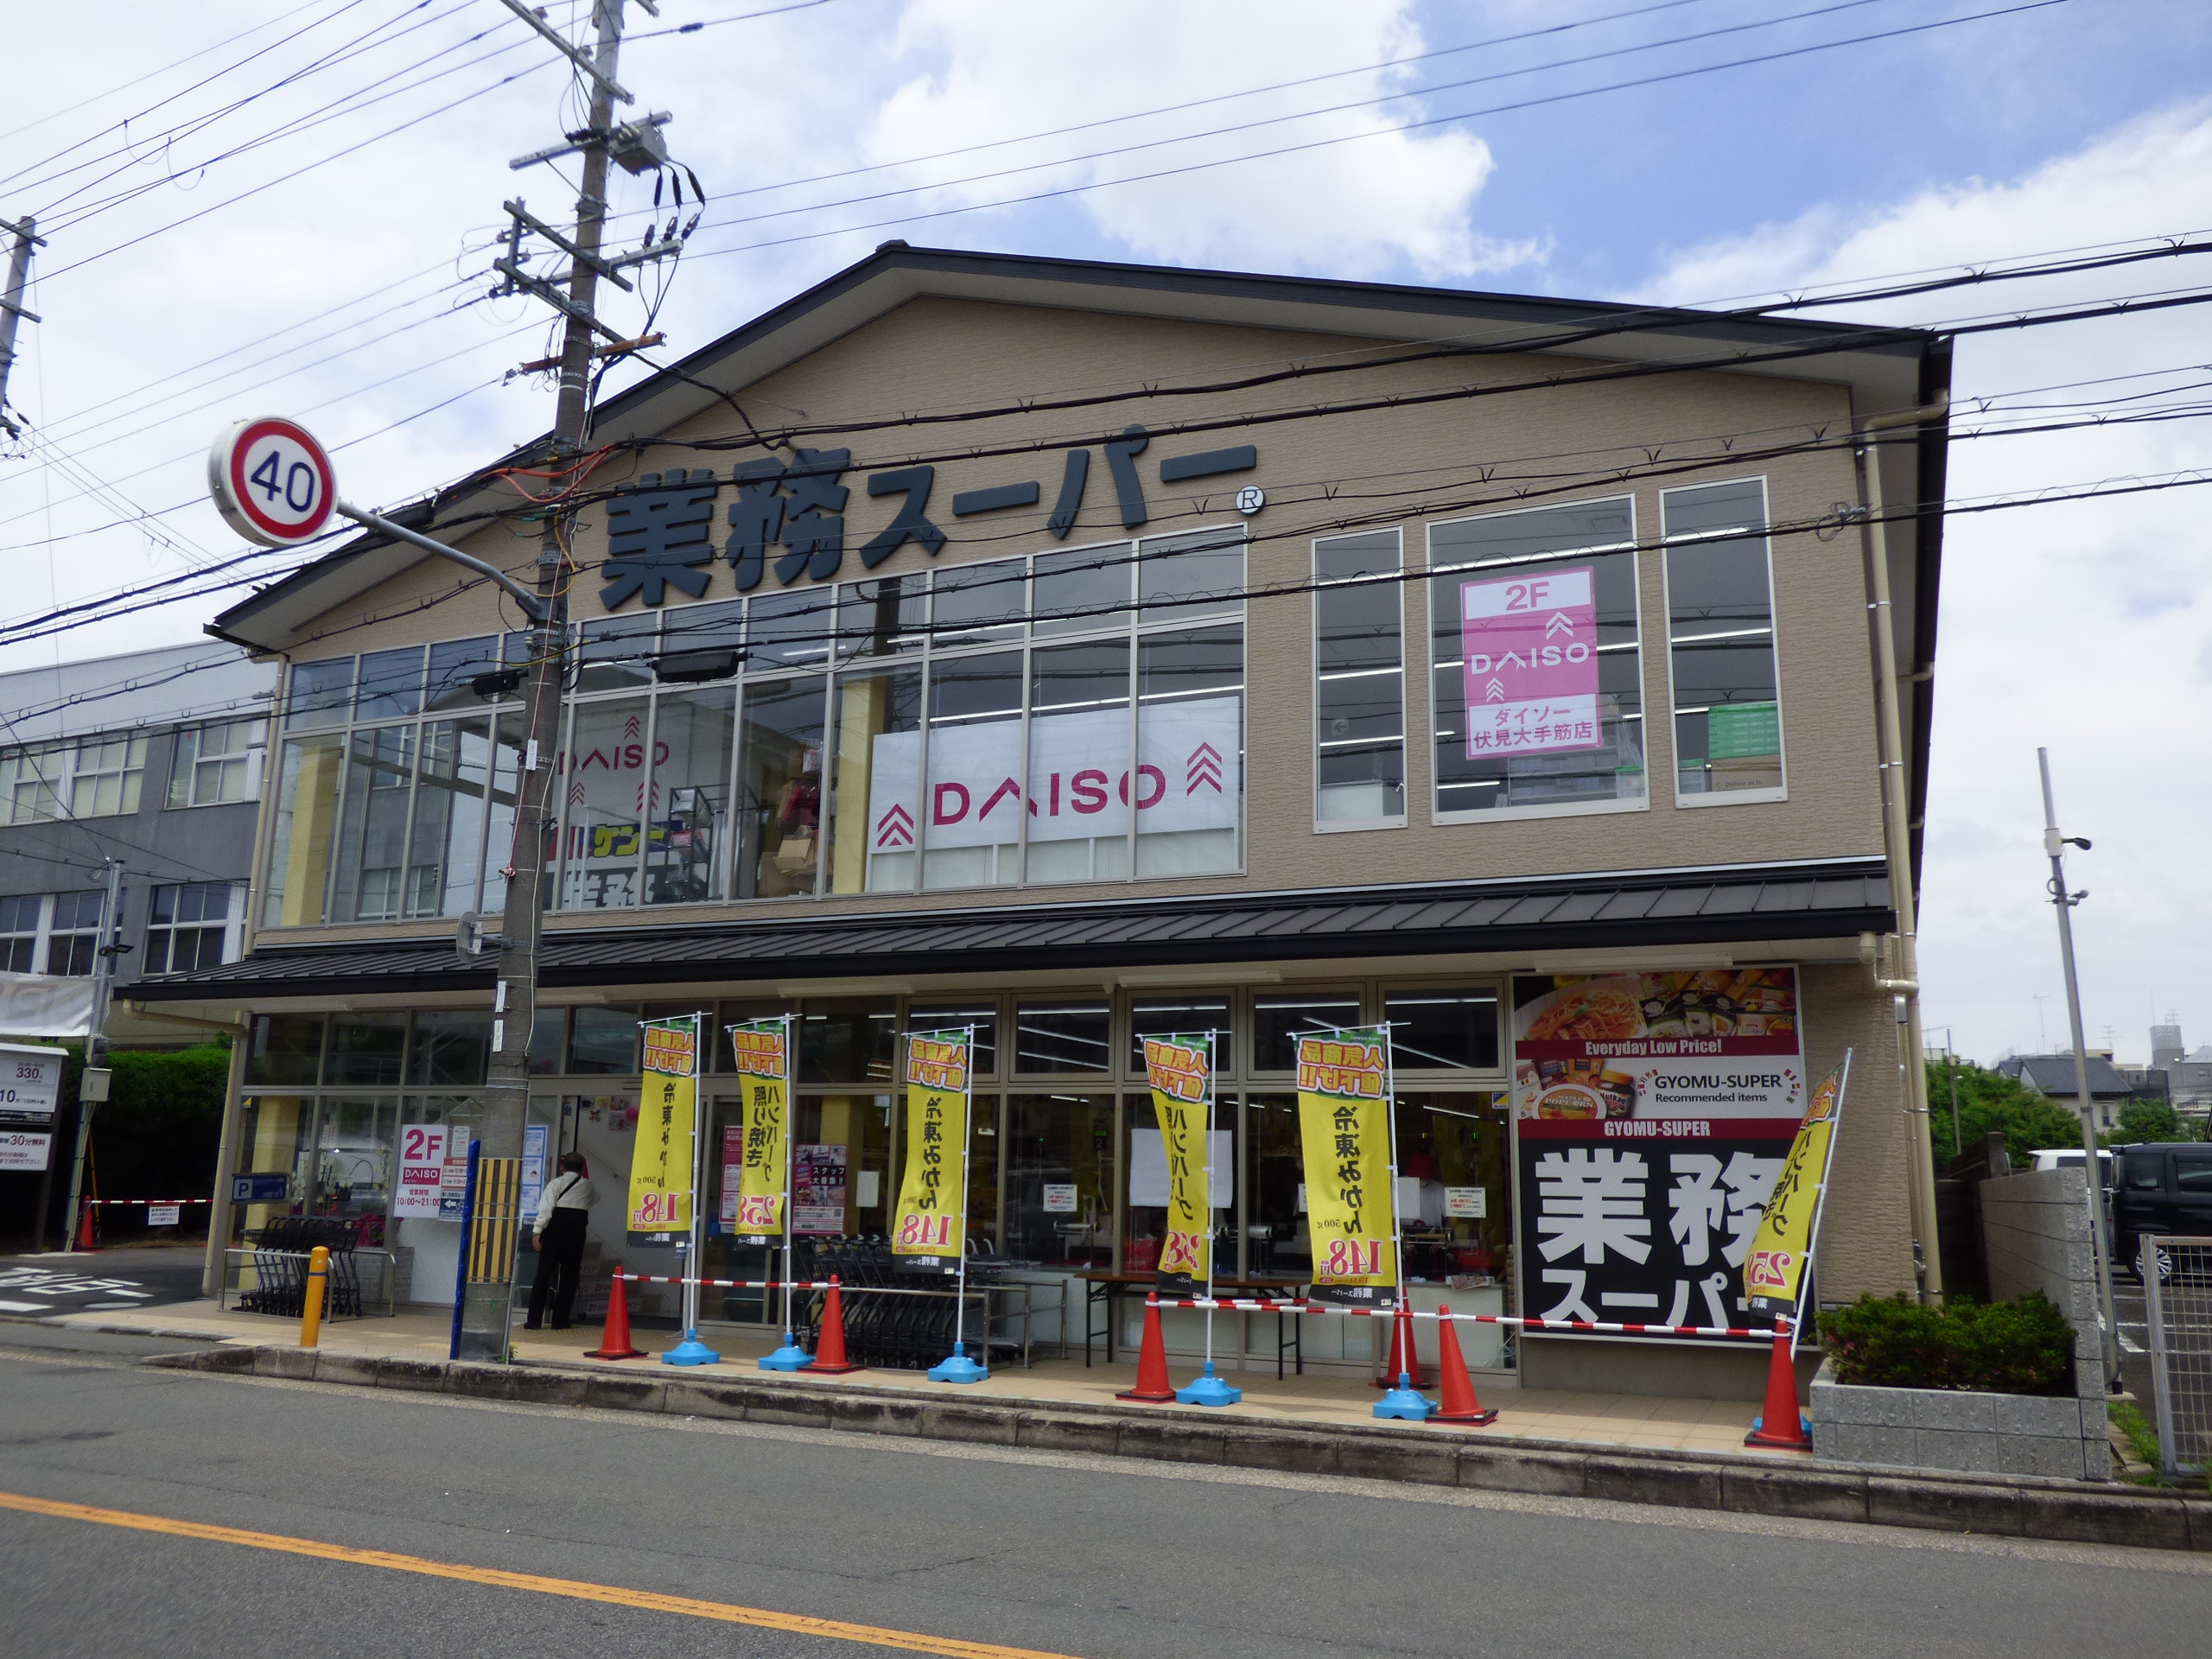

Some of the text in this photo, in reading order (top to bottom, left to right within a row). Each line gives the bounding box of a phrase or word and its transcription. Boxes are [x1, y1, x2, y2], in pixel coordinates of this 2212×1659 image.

[250, 450, 315, 512] 40
[598, 424, 1258, 612] 業務スーパー
[1505, 581, 1550, 612] 2F
[1471, 642, 1590, 675] DAISO
[1495, 706, 1571, 728] ダイソー
[1474, 721, 1592, 750] 伏見大手筋店
[932, 764, 1166, 826] DAISO
[1586, 1039, 1723, 1056] Everyday Low Price!
[1654, 1074, 1783, 1090] GYOMU-SUPER
[1656, 1092, 1768, 1103] Recommended items
[1604, 1121, 1711, 1137] GYOMU-SUPER
[404, 1128, 443, 1161] 2F
[404, 1169, 438, 1179] DAISO
[238, 1182, 249, 1197] P
[1535, 1147, 1789, 1268] 業務
[1540, 1268, 1750, 1330] スーパ
